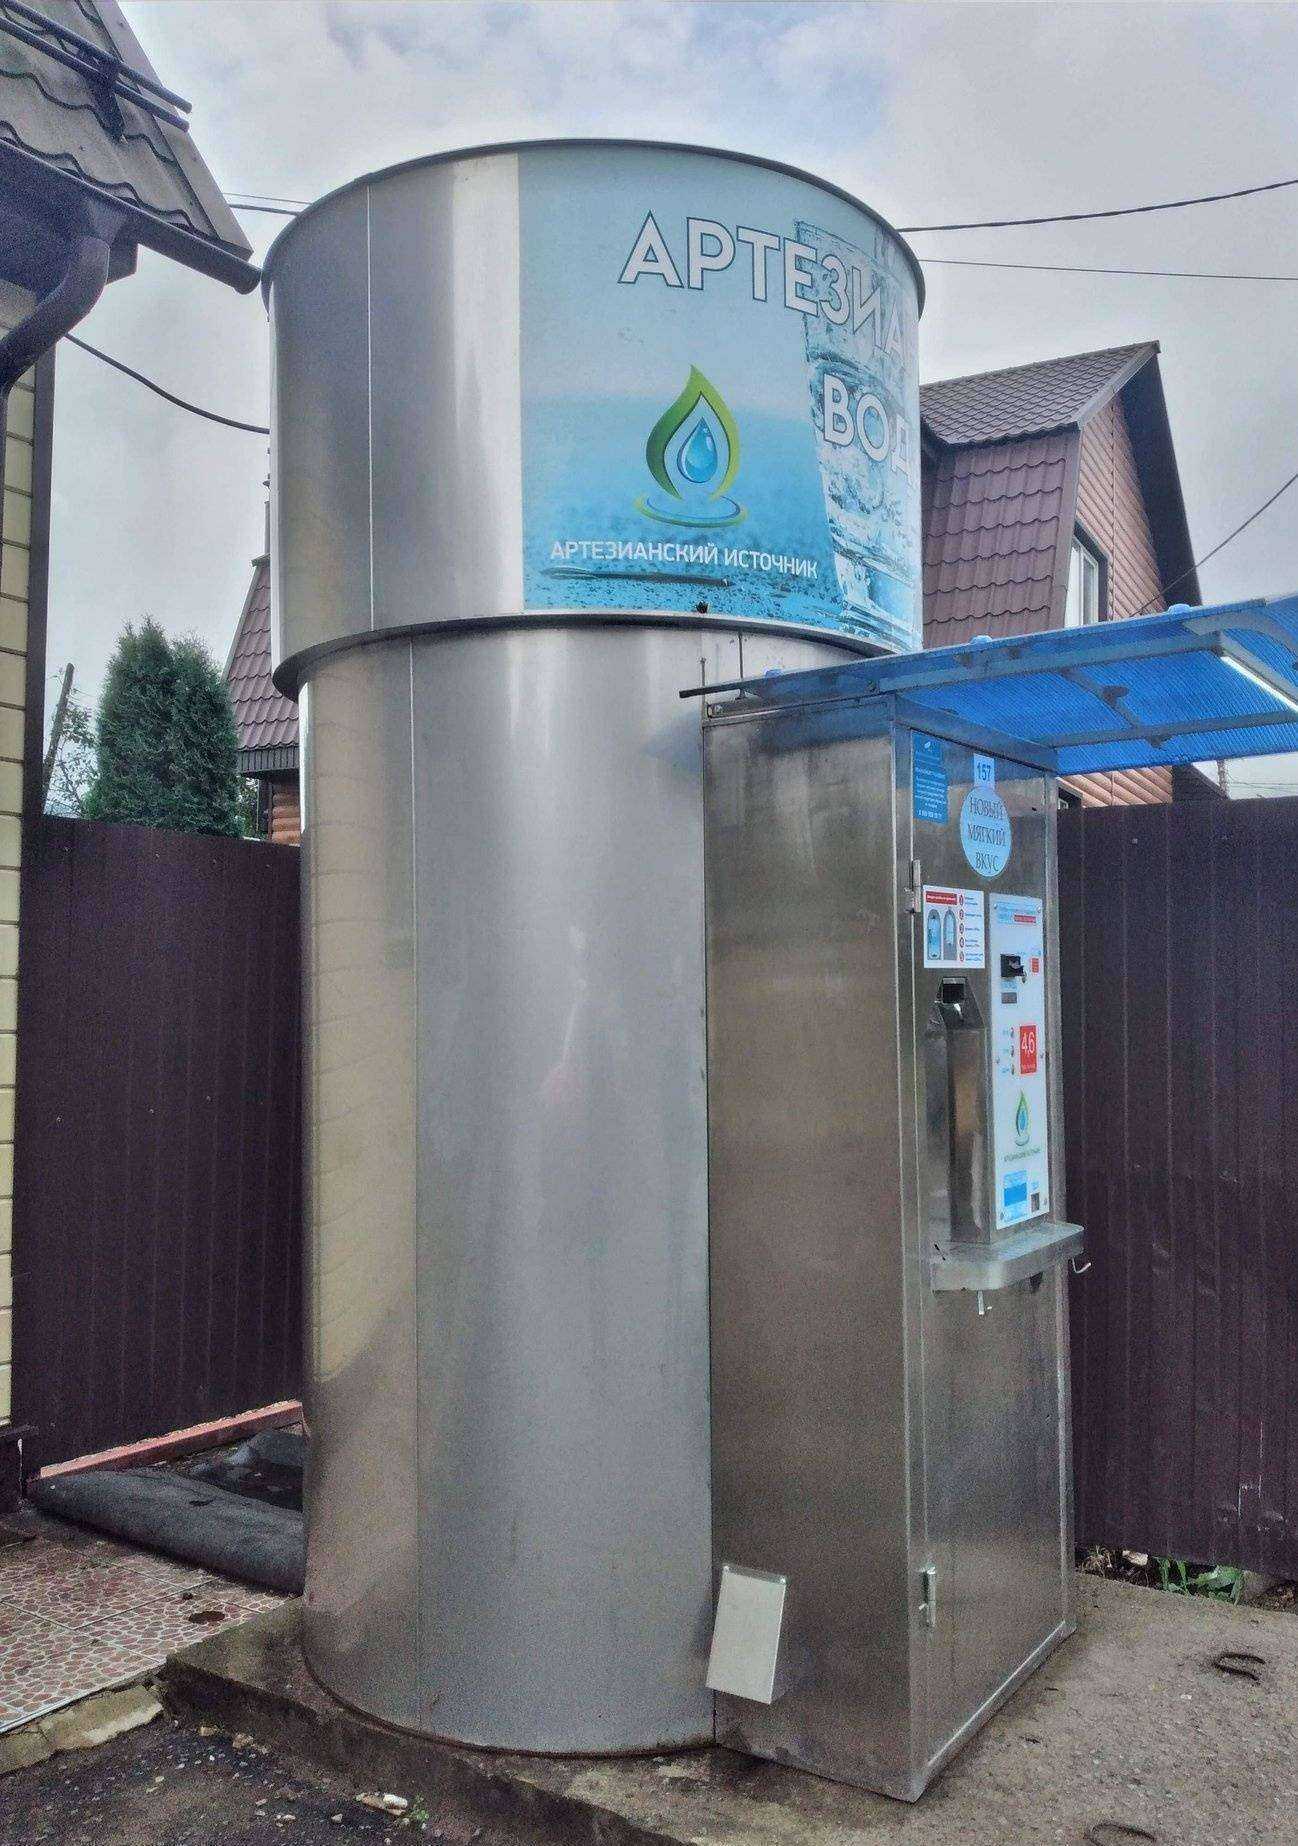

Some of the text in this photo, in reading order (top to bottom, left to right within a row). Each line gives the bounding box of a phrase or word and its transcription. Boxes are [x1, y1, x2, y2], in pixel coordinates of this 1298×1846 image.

[550, 540, 818, 579] АРТЕЗИАНСКИЙ ИСТОЧНИК
[975, 851, 999, 872] ВКУС
